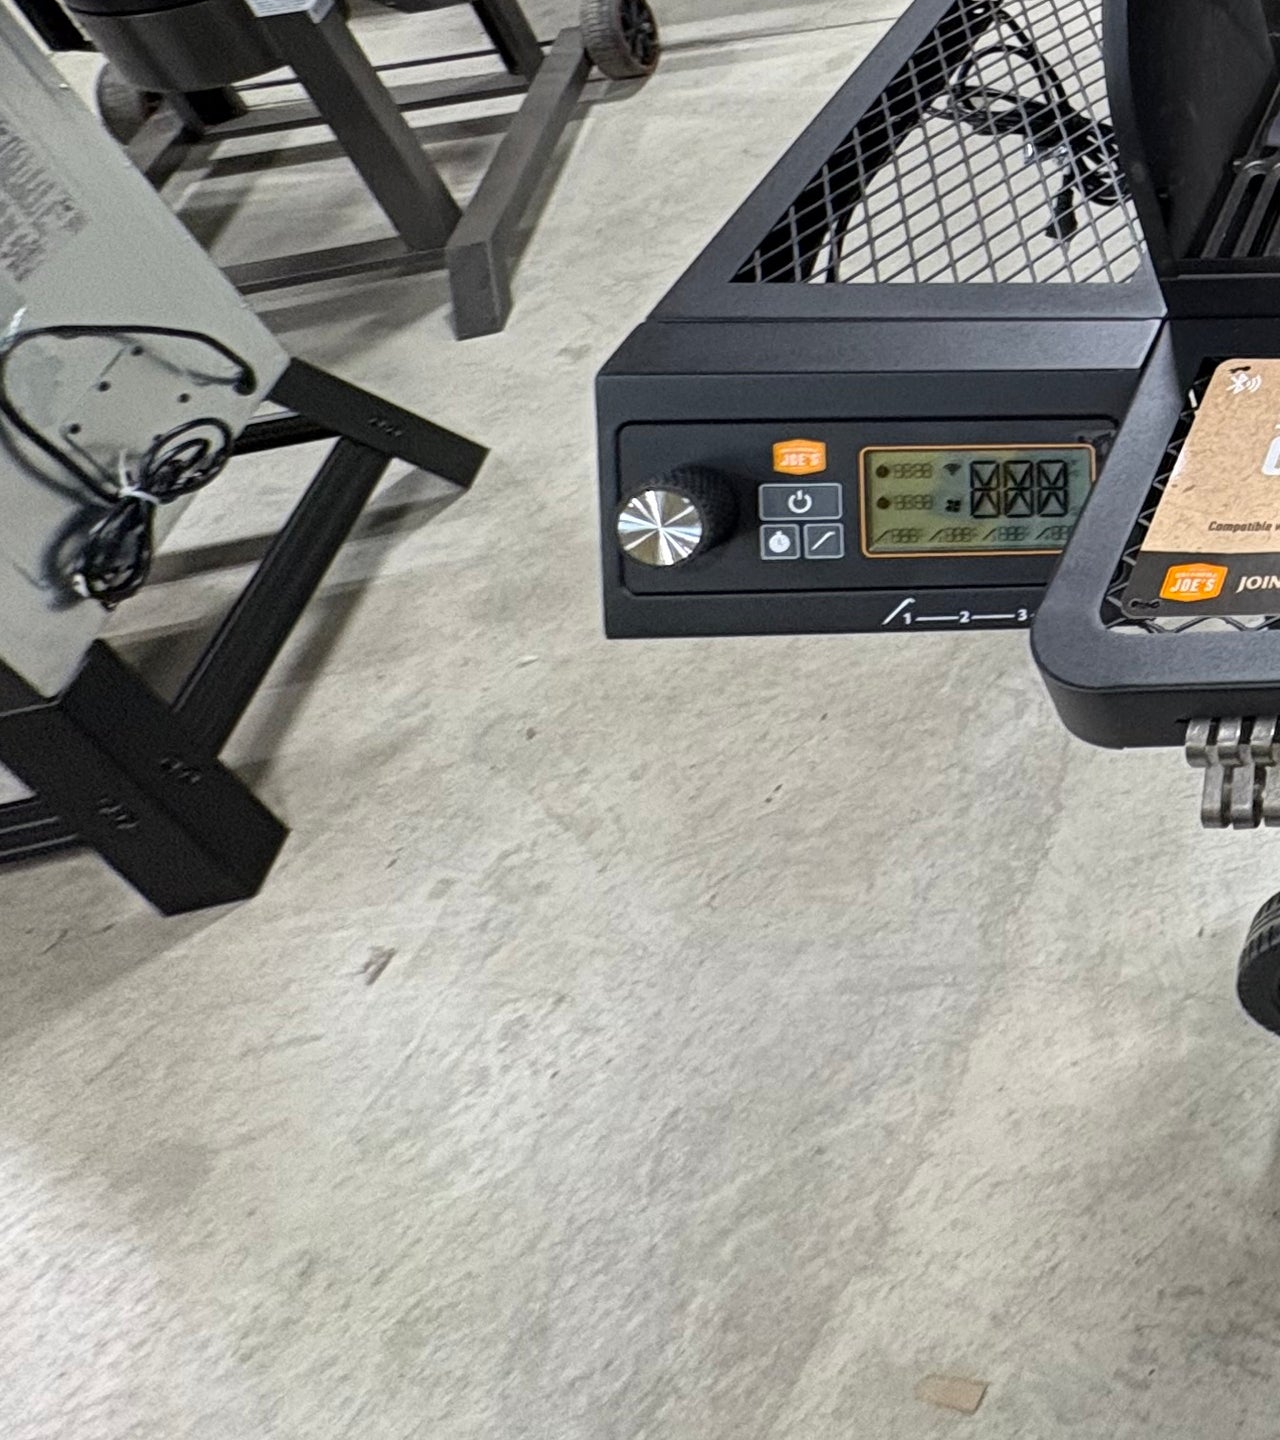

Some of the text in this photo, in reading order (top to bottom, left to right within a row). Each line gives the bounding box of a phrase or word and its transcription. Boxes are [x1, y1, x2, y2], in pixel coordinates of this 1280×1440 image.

[782, 452, 821, 467] JOE'S
[1208, 521, 1272, 533] Compatible
[1169, 578, 1216, 593] JOE'S
[903, 609, 1028, 625] 1 2 3
